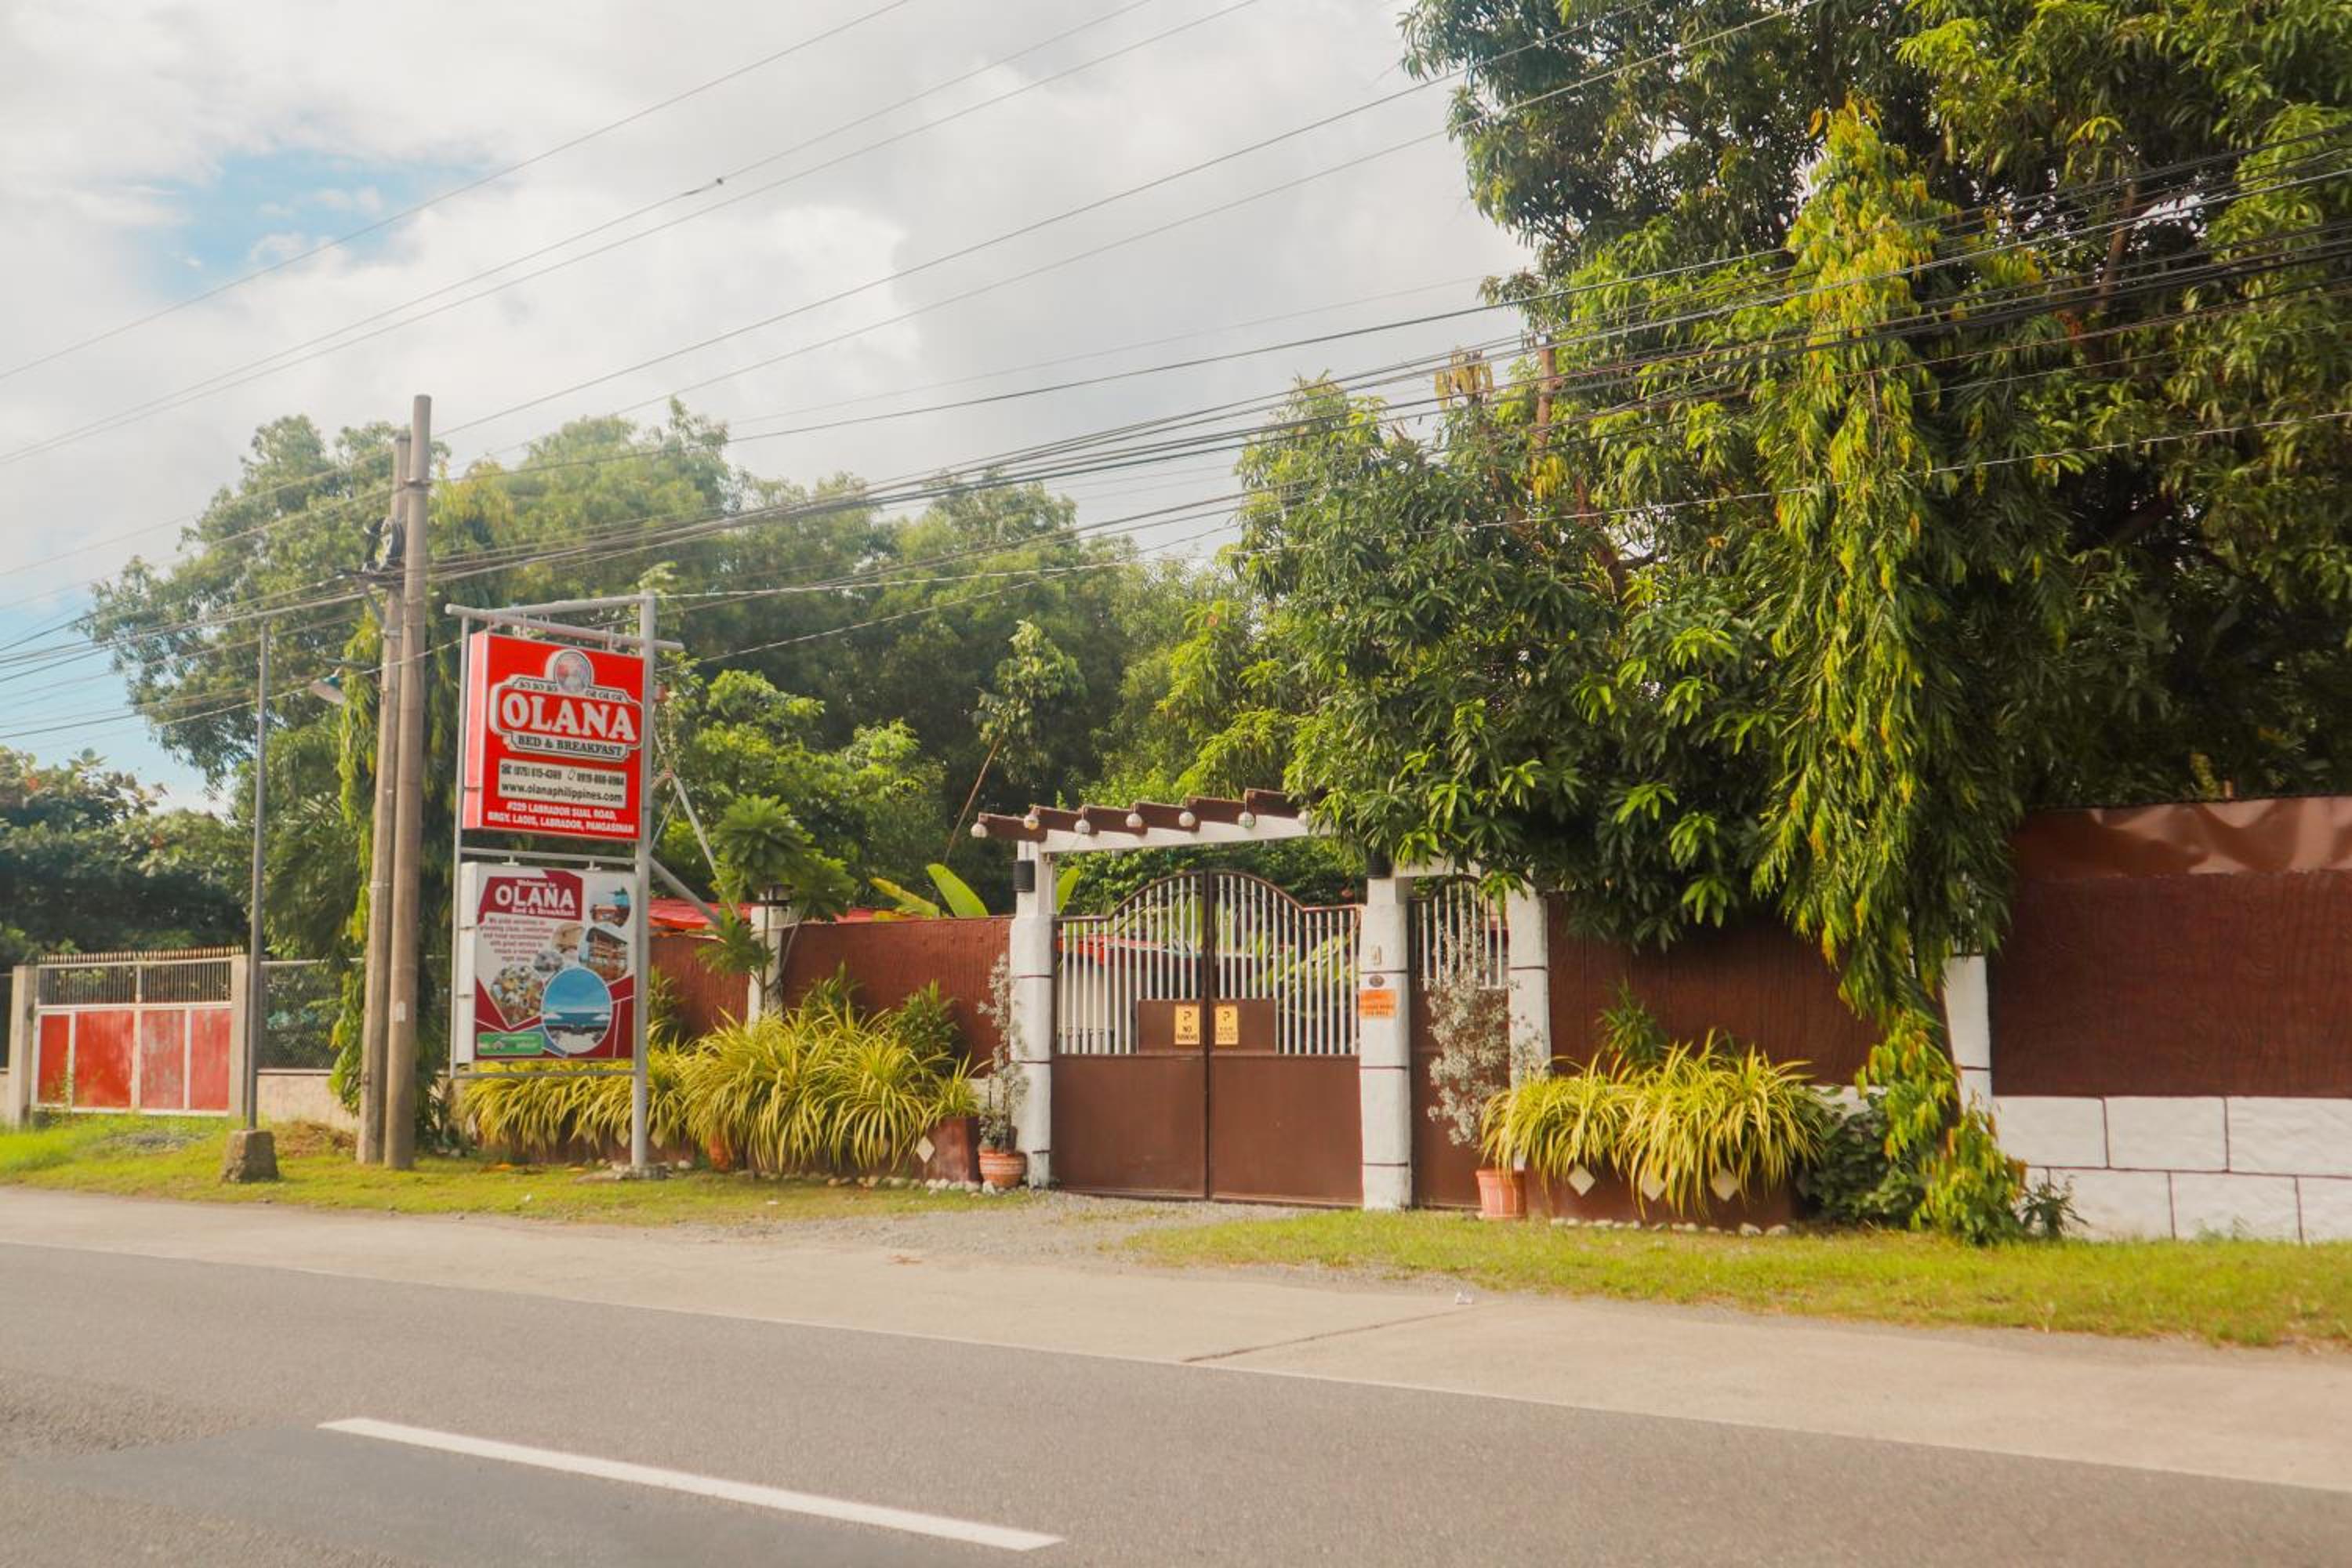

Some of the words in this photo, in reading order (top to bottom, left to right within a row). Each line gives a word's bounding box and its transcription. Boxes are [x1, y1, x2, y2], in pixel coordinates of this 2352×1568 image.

[502, 692, 636, 741] OLANA
[517, 735, 543, 747] BED
[544, 739, 554, 749] &
[557, 740, 623, 757] BREAKFAST
[501, 782, 623, 802] www.olanaphilippines.com
